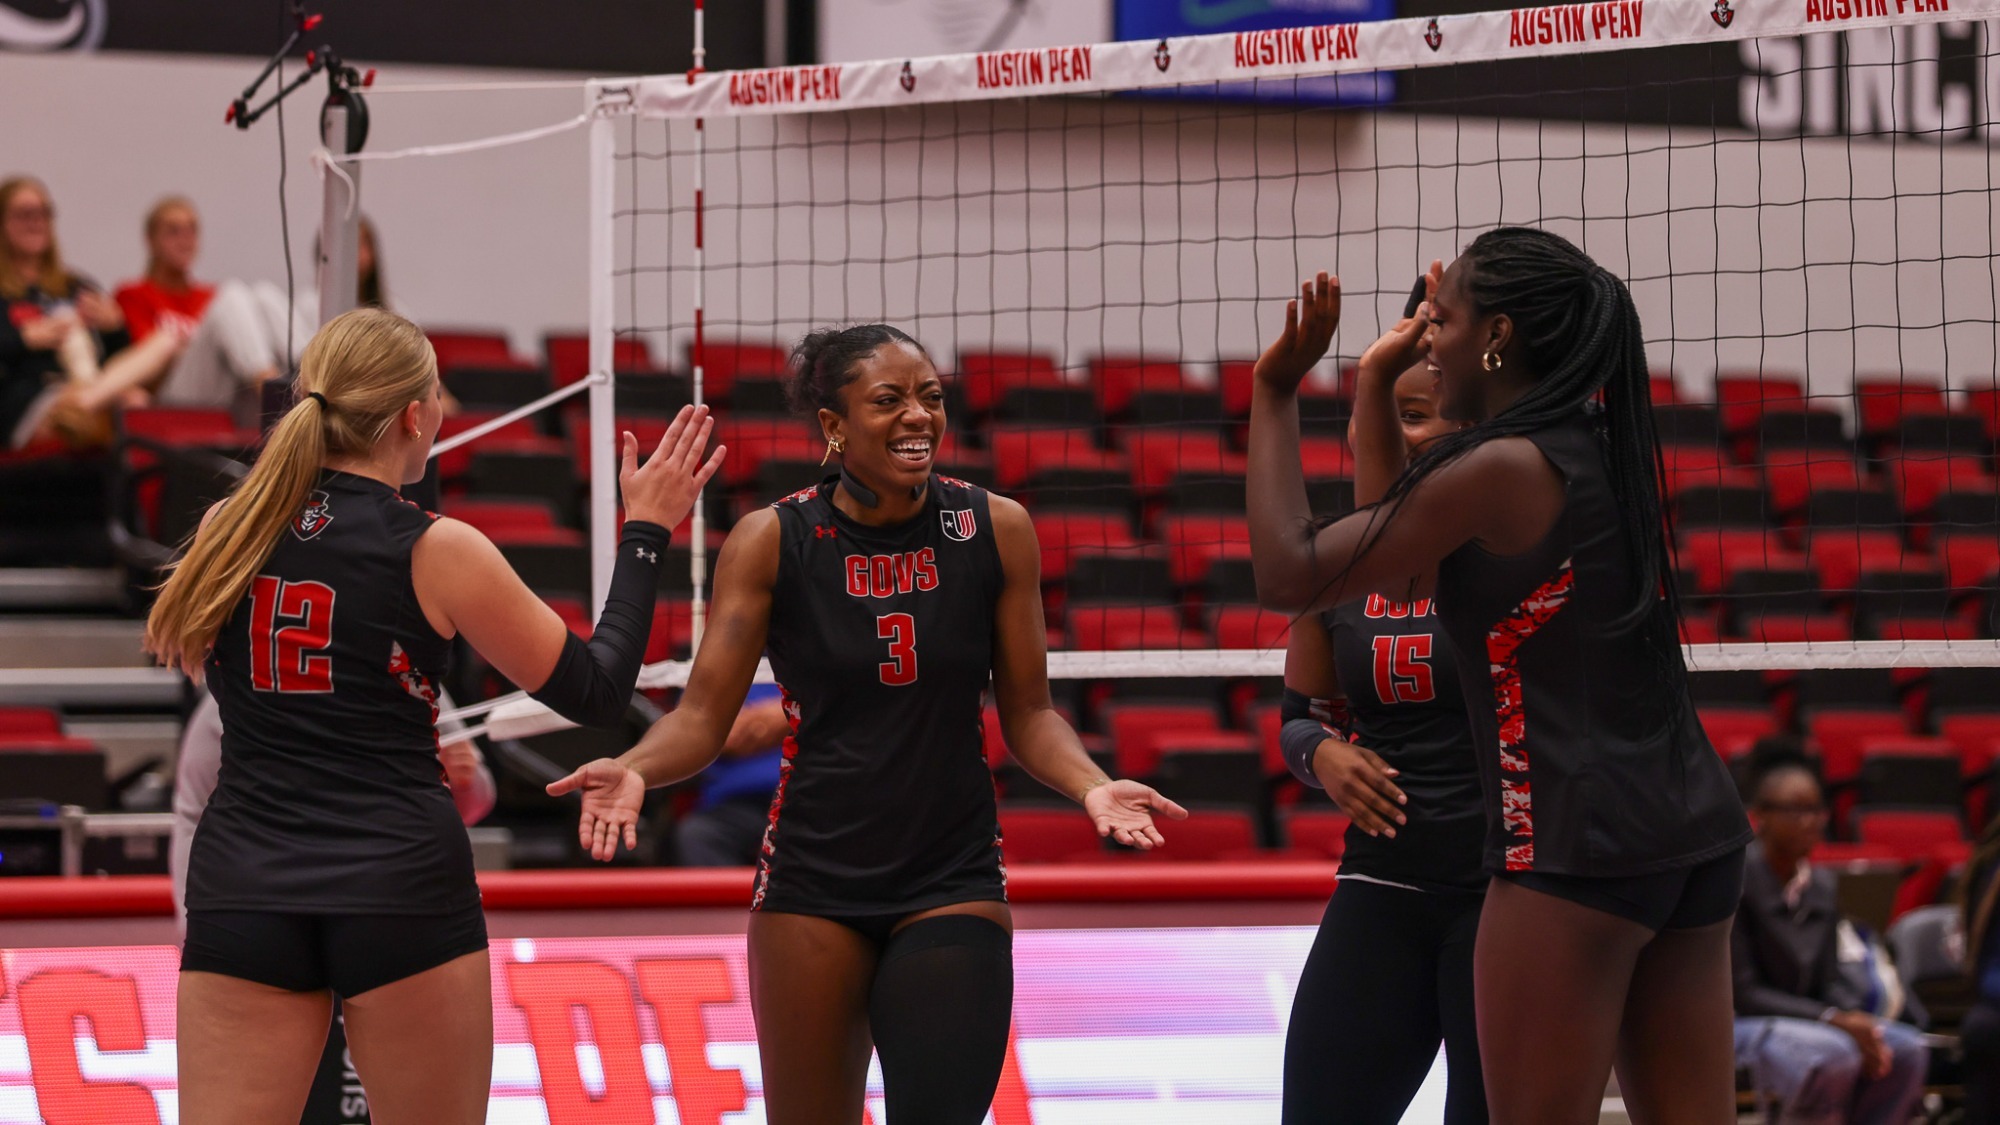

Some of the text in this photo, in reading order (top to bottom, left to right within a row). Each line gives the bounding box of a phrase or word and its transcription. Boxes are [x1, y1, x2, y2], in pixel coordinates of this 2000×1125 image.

[1235, 23, 1360, 68] AUSTIN PEAY
[1510, 0, 1644, 48] AUSTIN PEAY
[729, 65, 842, 107] AUSTIN PEAY
[976, 45, 1093, 88] AUSTIN PEAY
[845, 546, 940, 599] GOVS
[248, 573, 337, 694] 12
[876, 612, 918, 686] 3
[1371, 633, 1436, 704] 15
